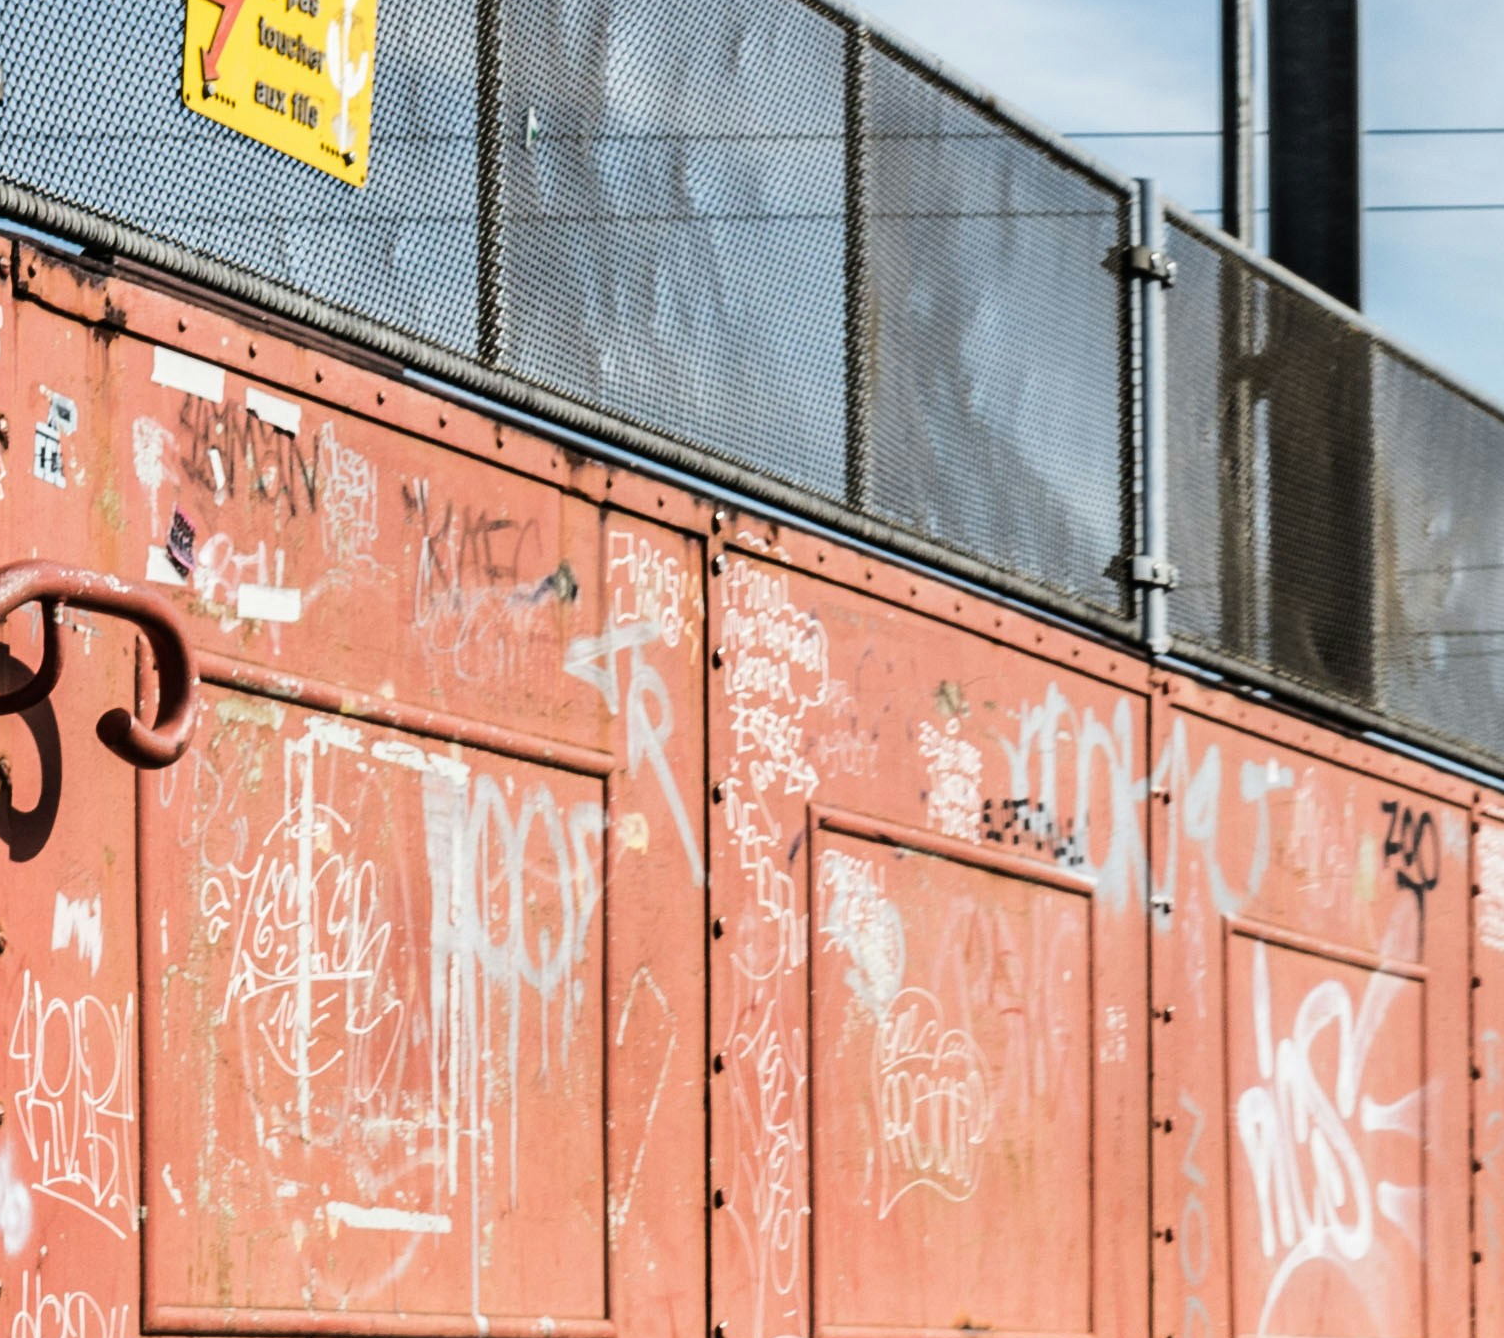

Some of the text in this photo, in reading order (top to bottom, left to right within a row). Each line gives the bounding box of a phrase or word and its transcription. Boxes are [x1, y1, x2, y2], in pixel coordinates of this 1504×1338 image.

[259, 17, 326, 74] toucher
[255, 81, 319, 128] aux fils
